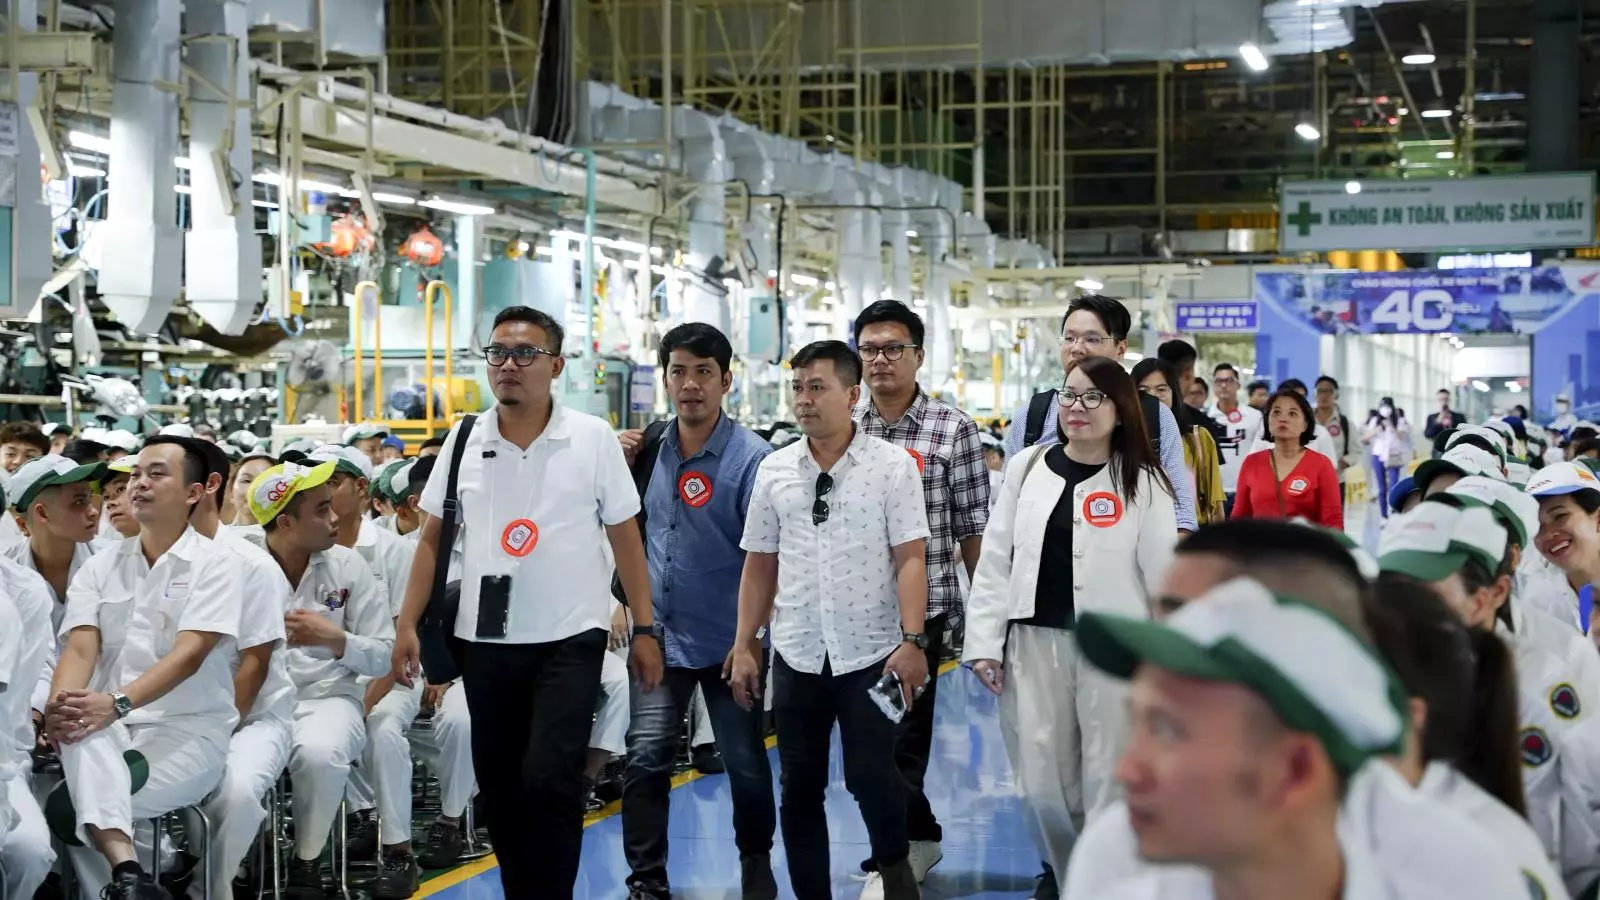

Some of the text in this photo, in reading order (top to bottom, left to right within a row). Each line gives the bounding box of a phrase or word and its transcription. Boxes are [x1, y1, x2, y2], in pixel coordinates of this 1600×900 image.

[1329, 204, 1378, 226] KHÔNG
[1382, 206, 1403, 225] AN
[1454, 201, 1505, 223] KHÔNG
[267, 480, 288, 501] QG
